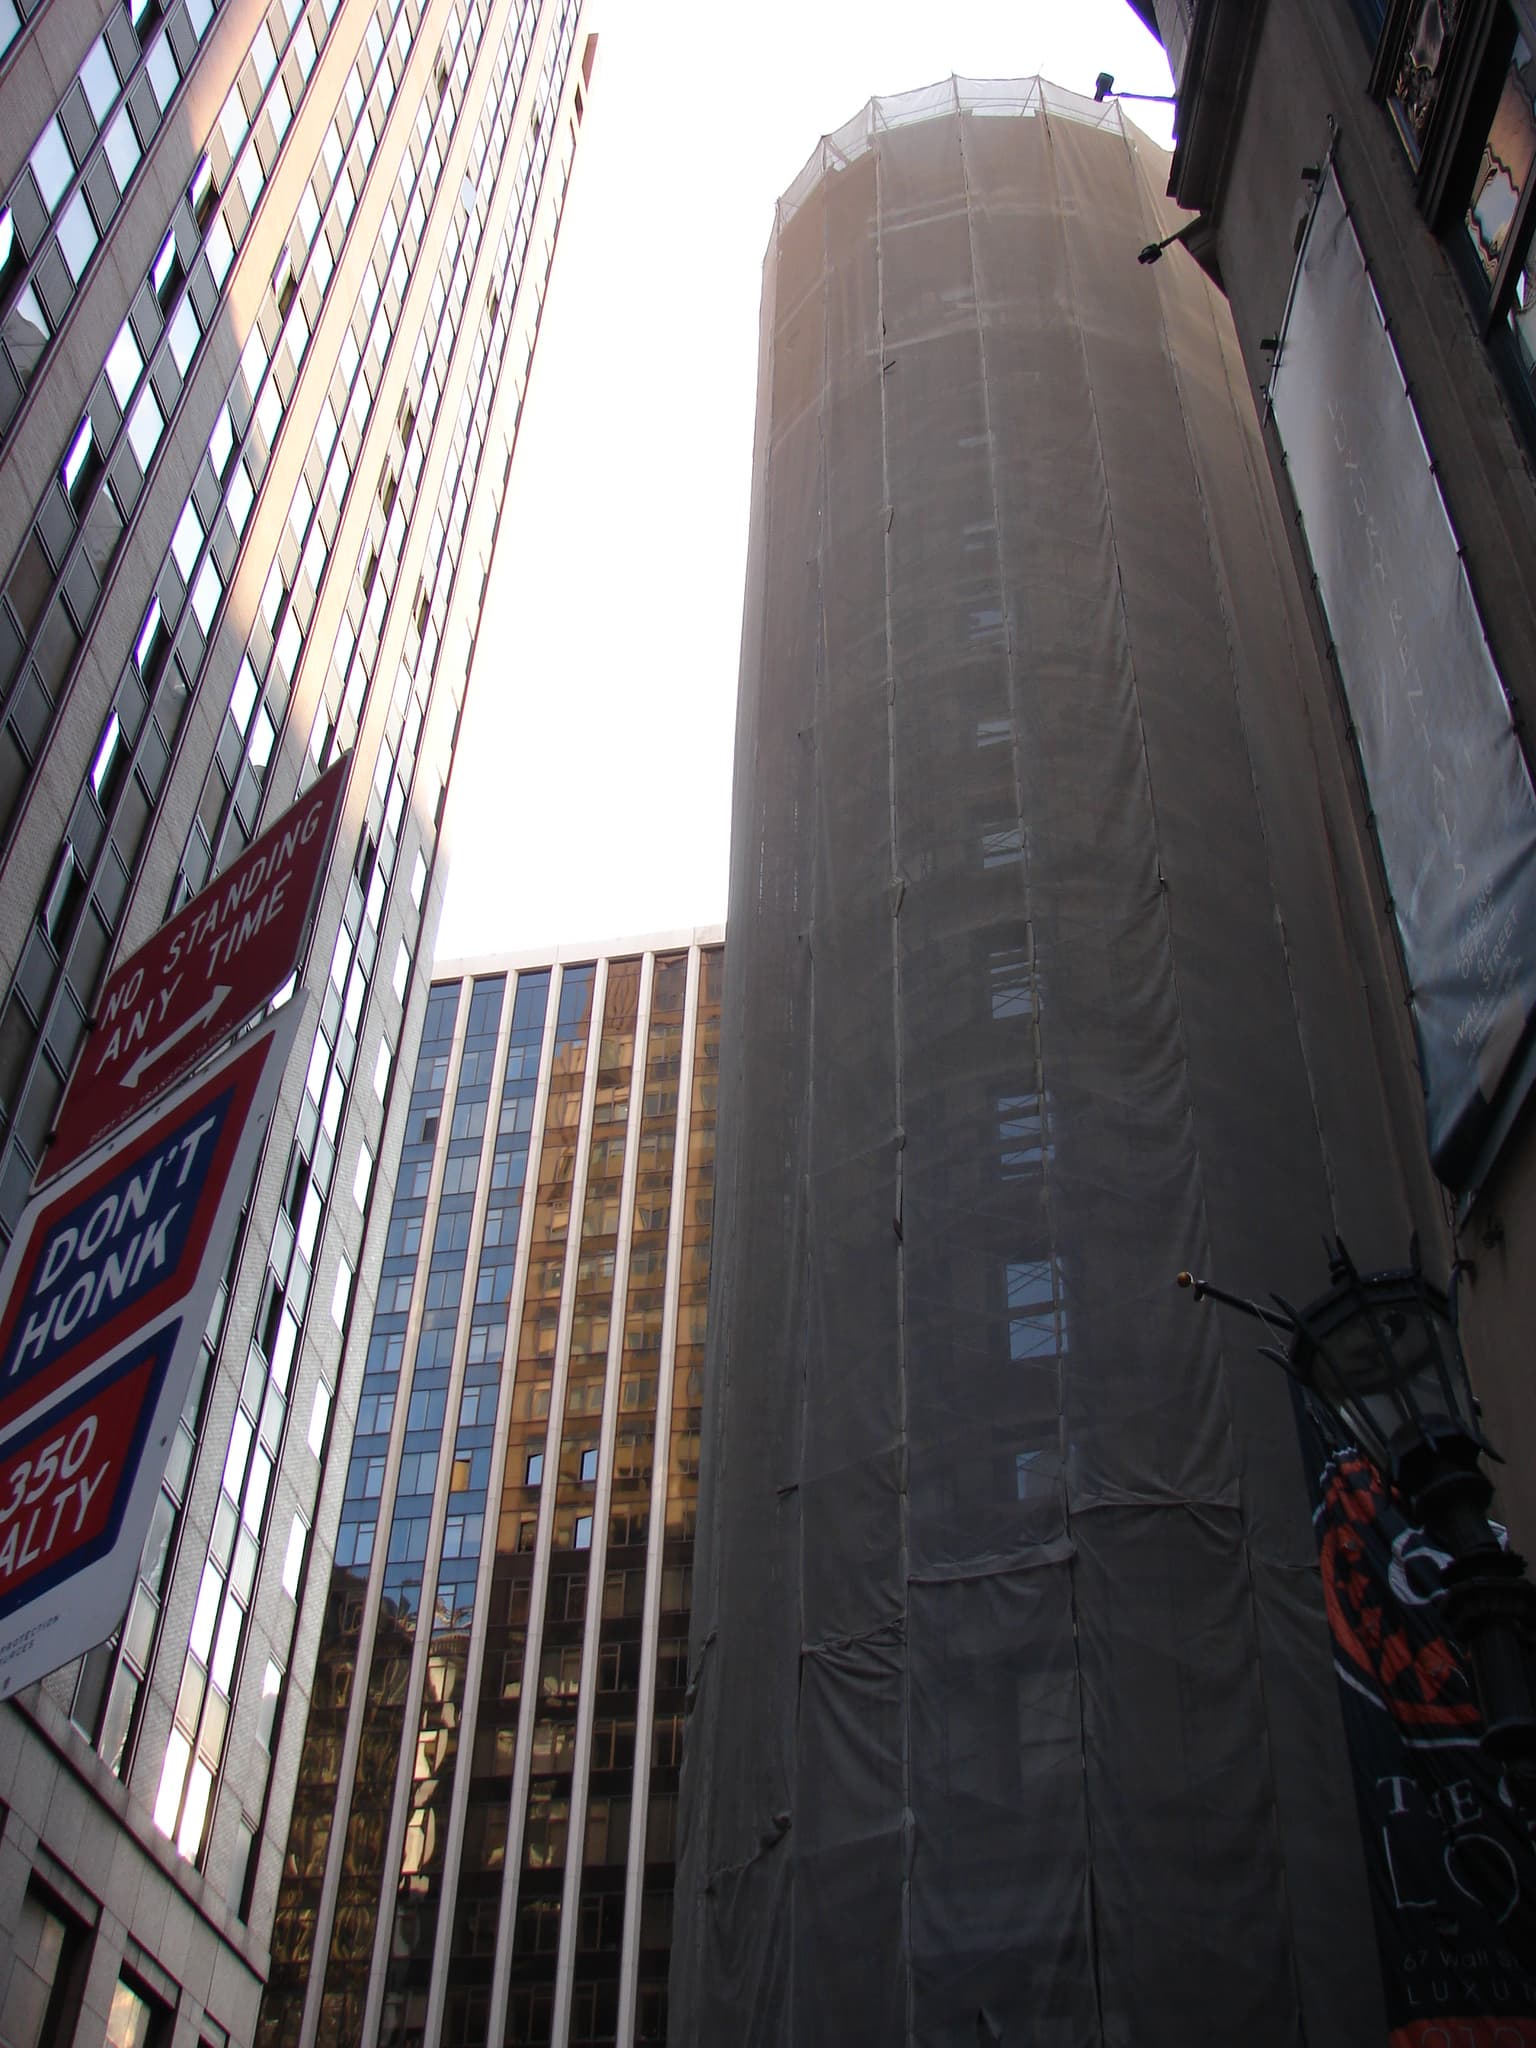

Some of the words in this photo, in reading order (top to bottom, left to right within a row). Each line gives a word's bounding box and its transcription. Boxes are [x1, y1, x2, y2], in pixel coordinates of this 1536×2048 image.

[95, 974, 183, 1076] ANY
[207, 871, 293, 979] TIME
[101, 968, 144, 1031] NO
[163, 801, 323, 975] STANDING
[1453, 991, 1485, 1046] WALL
[1482, 903, 1520, 993] STREET
[9, 1203, 181, 1376] HONK
[36, 1116, 216, 1295] DON'T
